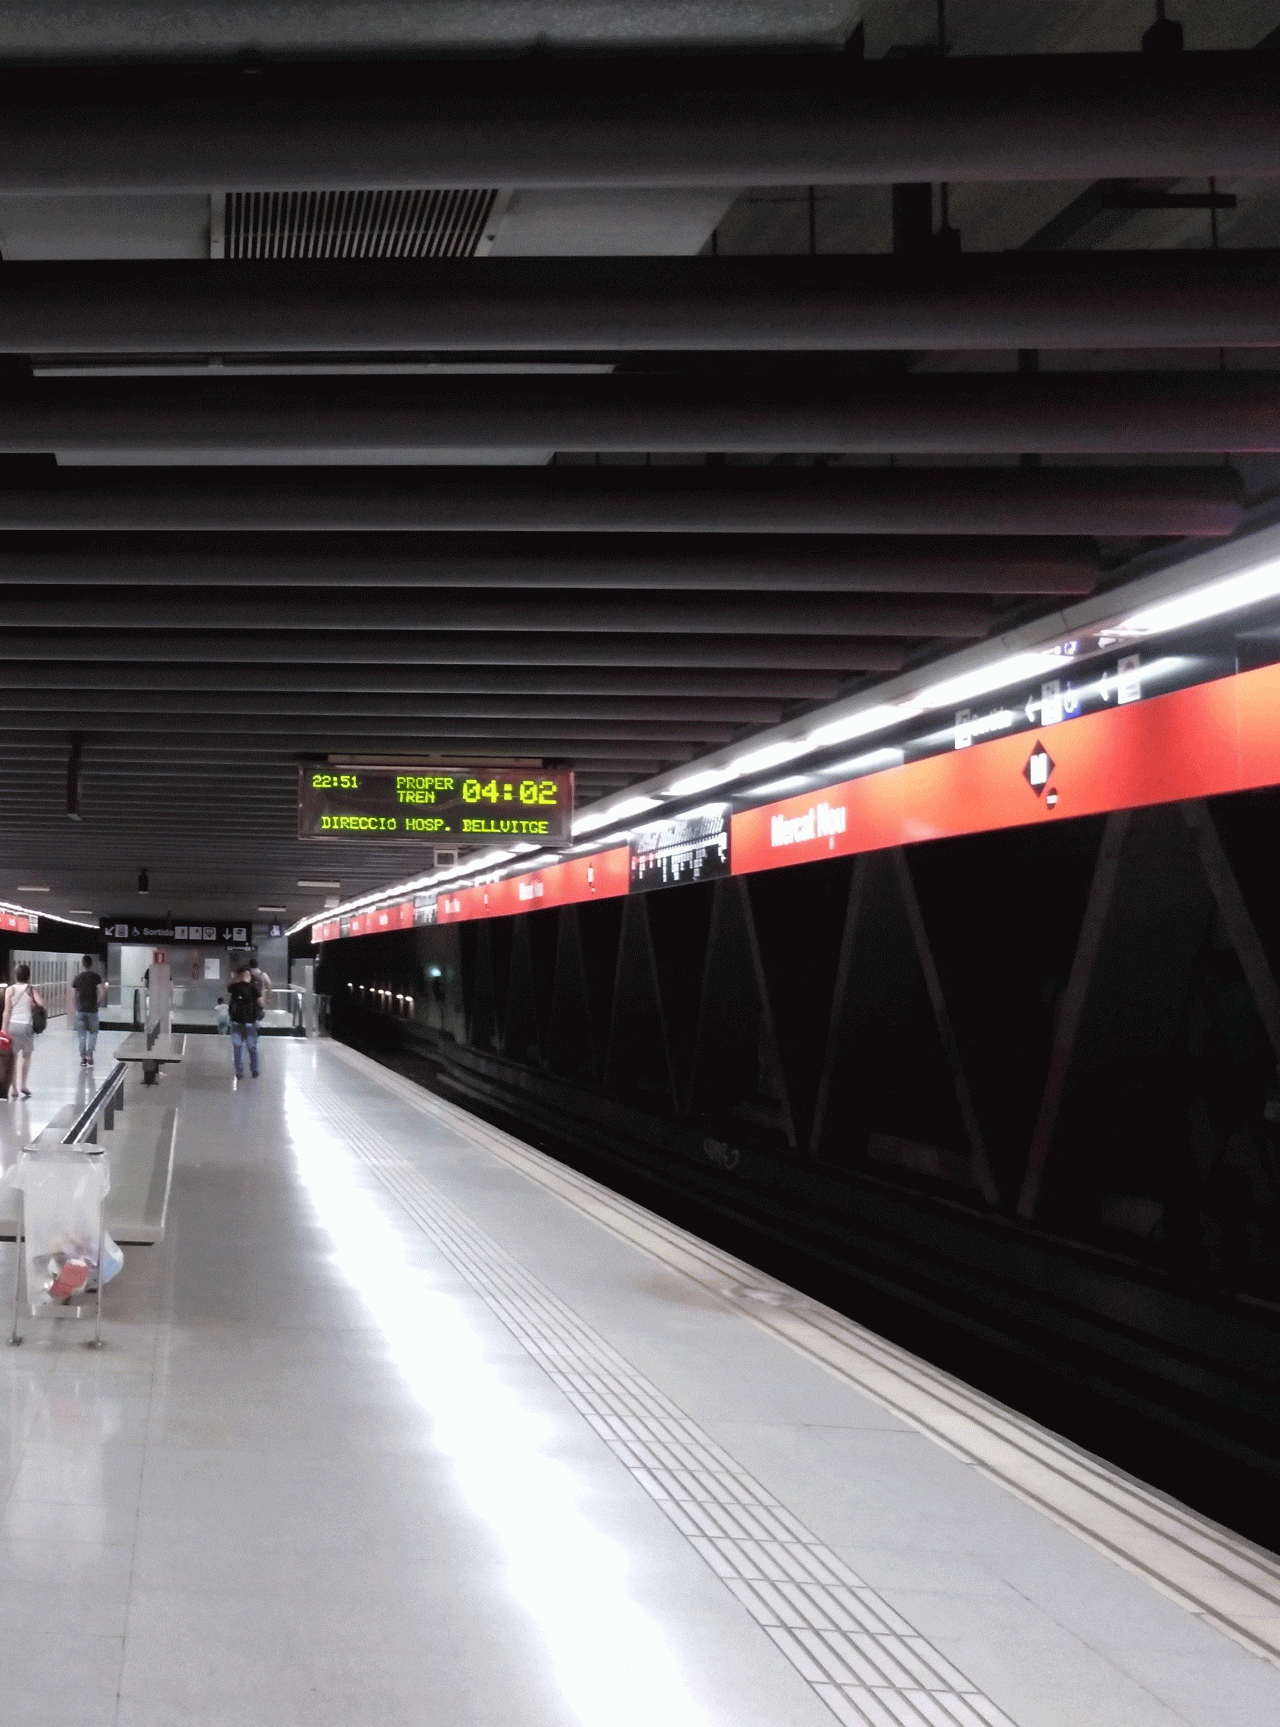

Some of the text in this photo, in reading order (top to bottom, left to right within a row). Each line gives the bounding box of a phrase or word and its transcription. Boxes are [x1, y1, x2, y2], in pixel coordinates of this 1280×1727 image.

[312, 776, 358, 788] 22:51
[397, 777, 557, 804] PROPER 04:02
[397, 790, 436, 803] TREN
[405, 818, 451, 832] HOSP.
[462, 819, 549, 834] BELLVITGE
